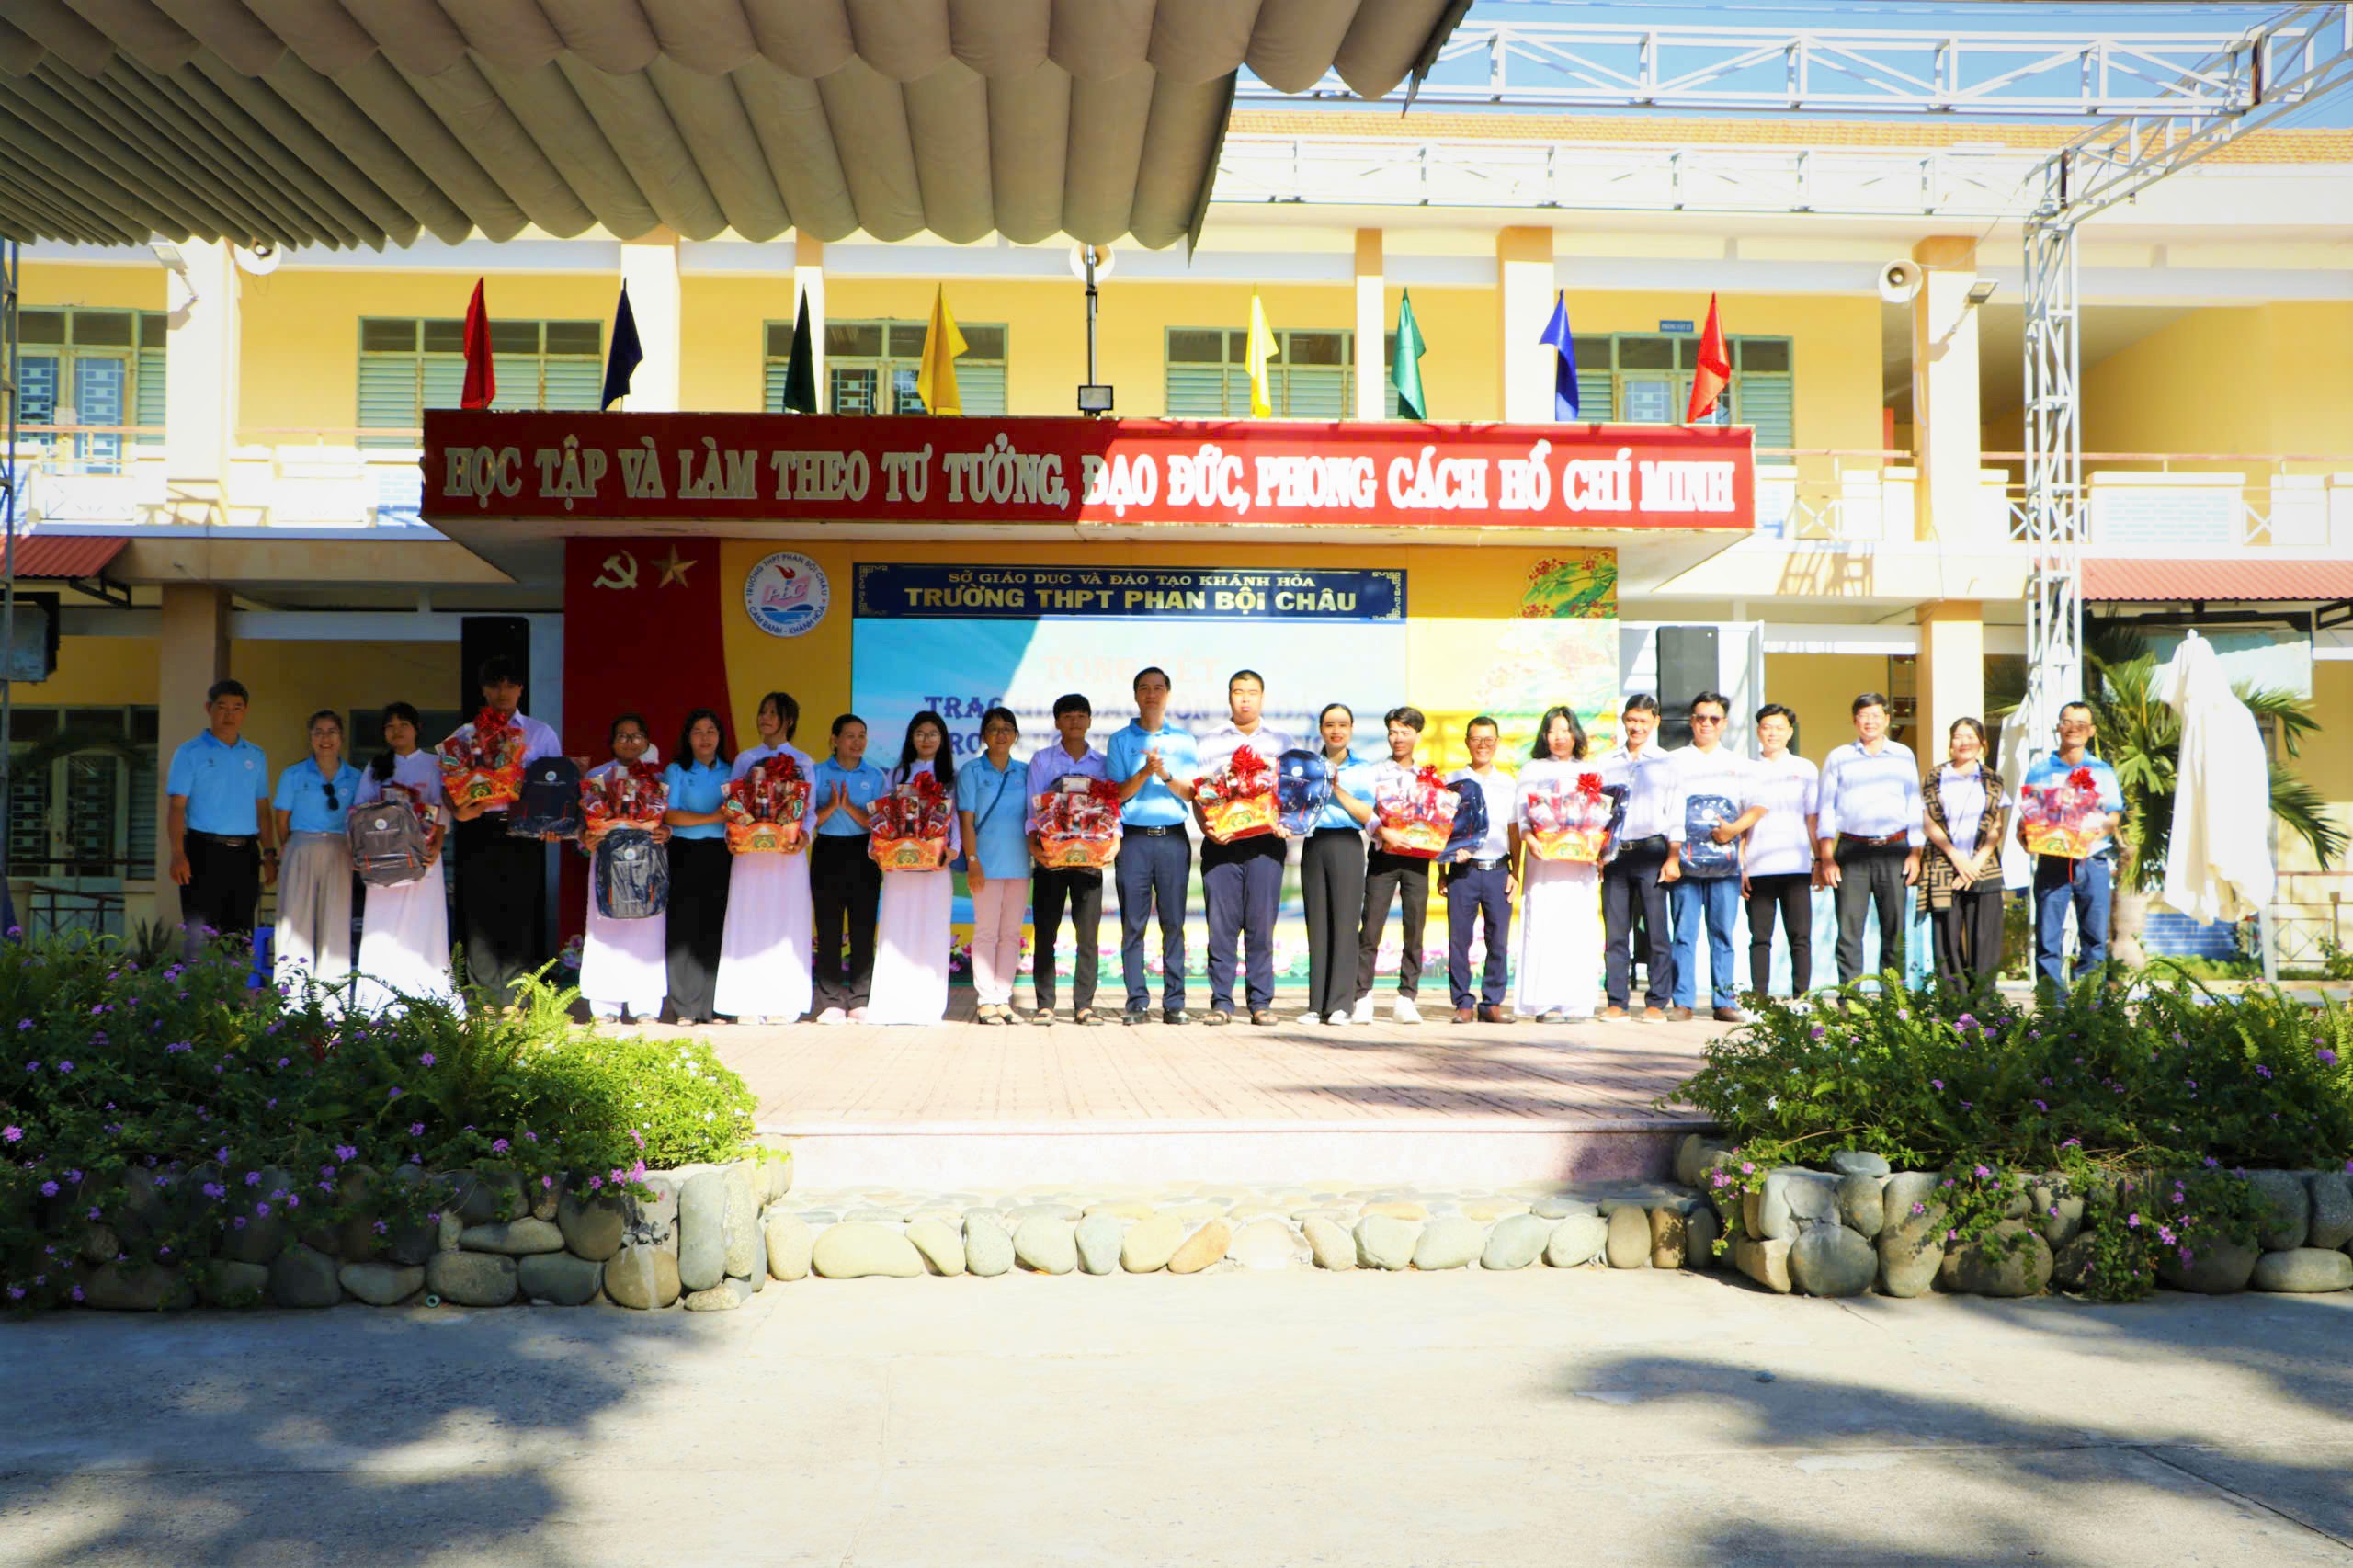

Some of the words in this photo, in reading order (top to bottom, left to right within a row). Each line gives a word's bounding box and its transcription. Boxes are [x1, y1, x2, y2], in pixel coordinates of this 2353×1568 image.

[443, 446, 522, 508] HỌC
[534, 434, 608, 510] TẬP
[618, 436, 666, 499] VÀ
[678, 437, 758, 499] LÀM
[770, 450, 870, 501] THEO
[881, 442, 933, 503] TƯ
[943, 433, 1070, 511] TƯỞNG,
[1081, 454, 1158, 517] ĐẠO
[1167, 444, 1250, 515] ĐỨC,
[1255, 455, 1378, 508] PHONG
[1387, 445, 1488, 510] CÁCH
[1498, 438, 1552, 511] HỒ
[1563, 447, 1632, 512] CHÍ
[1639, 460, 1736, 512] MINH
[781, 553, 805, 564] PHAN
[948, 570, 972, 583] SỞ
[979, 571, 1027, 584] GIÁO
[1033, 574, 1072, 586] DỤC
[1079, 572, 1103, 585] VÀ
[1109, 574, 1148, 585] ĐÀO
[1156, 575, 1192, 588] TẠO
[1199, 574, 1270, 586] KHÁNH
[1277, 574, 1316, 587] HÒA
[904, 585, 1025, 608] TRƯỜNG
[1034, 589, 1114, 608] THPT
[1124, 591, 1206, 609] PHAN
[1214, 586, 1266, 615] BỘI
[1275, 588, 1357, 611] CHÂU
[748, 605, 764, 624] CAM
[762, 619, 783, 634] RANH
